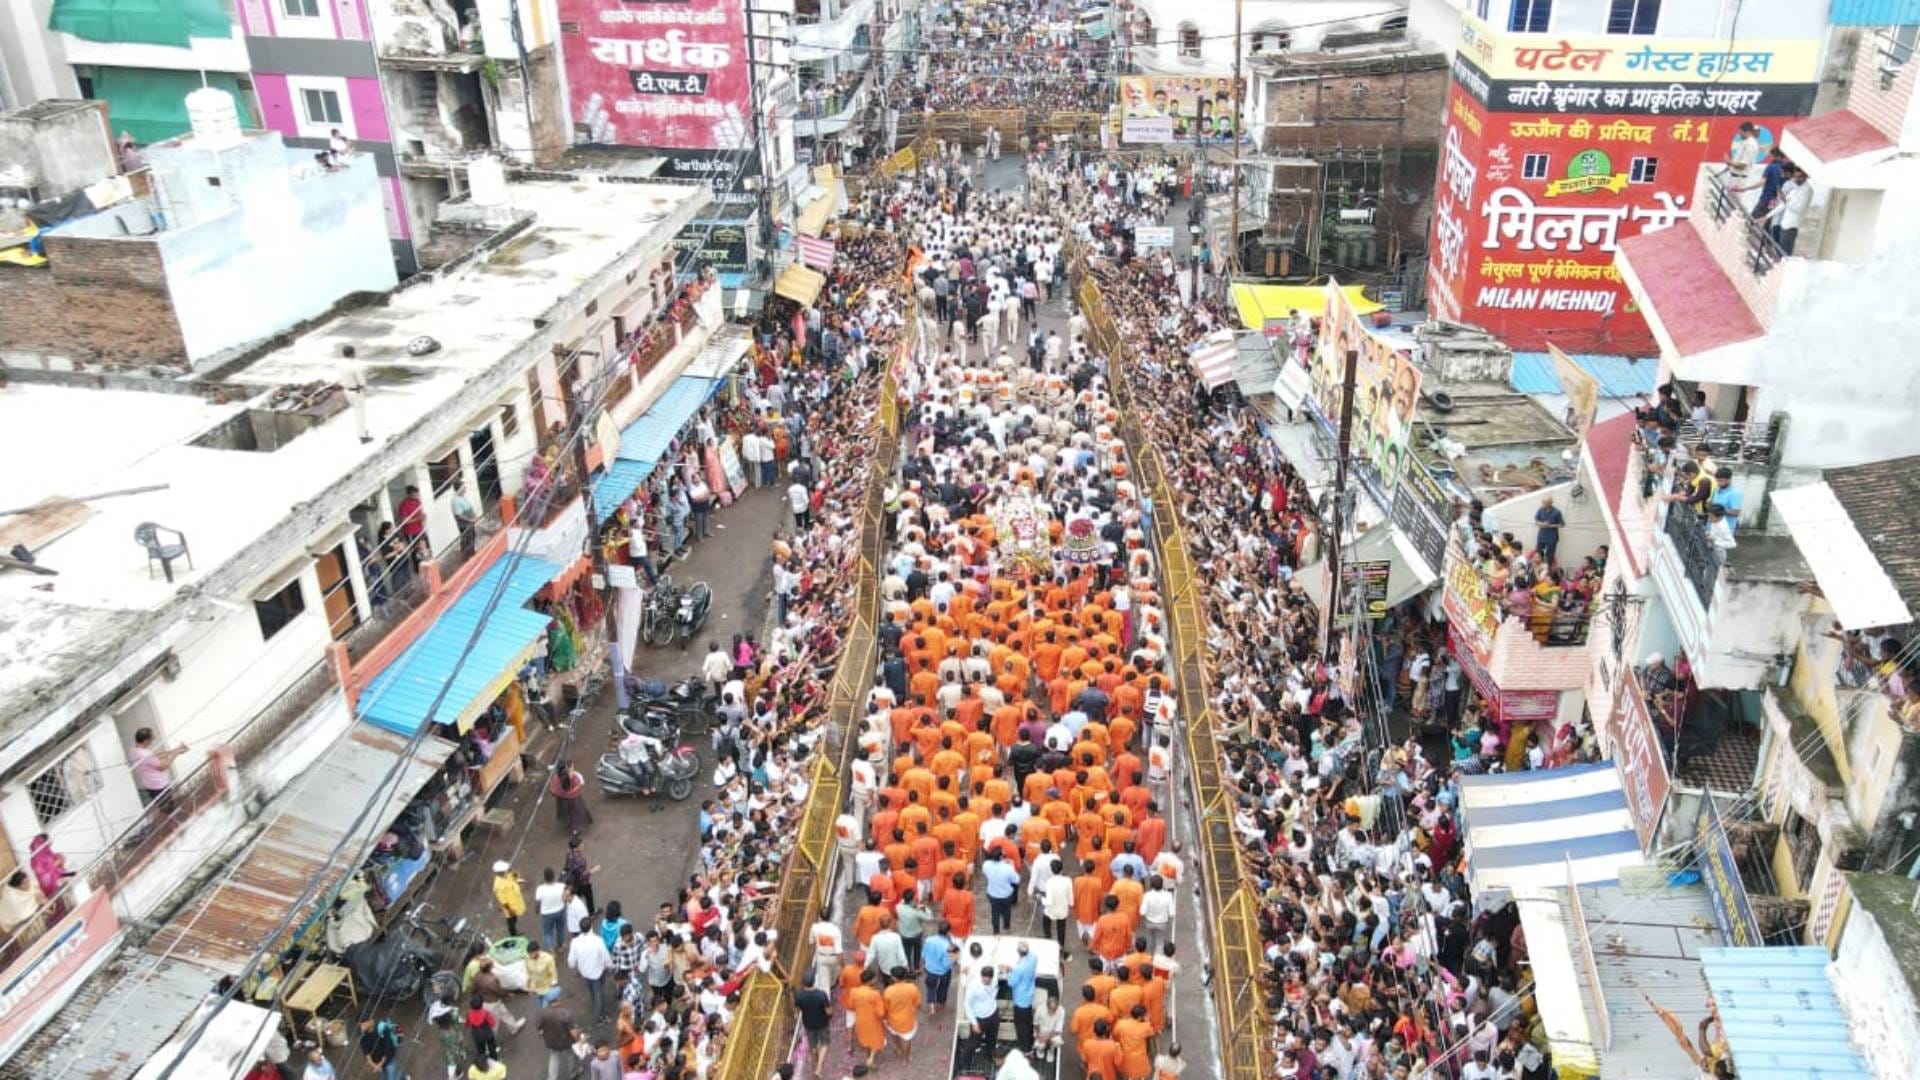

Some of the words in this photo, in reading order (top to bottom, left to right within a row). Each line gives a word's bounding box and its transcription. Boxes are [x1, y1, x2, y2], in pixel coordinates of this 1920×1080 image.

[588, 29, 730, 68] सार्थक
[1514, 40, 1613, 72] पटेल
[1626, 44, 1694, 71] गेस्ट
[1697, 51, 1773, 77] हाउस
[1508, 81, 1551, 107] नारी
[1604, 88, 1628, 108] का
[1630, 83, 1703, 114] प्राकृतिक
[1703, 86, 1762, 113] उपहार
[1510, 118, 1564, 138] उज्जैन
[1568, 118, 1593, 140] की
[1598, 119, 1656, 143] प्रसिद्ध
[674, 158, 714, 171] Sarthak
[1482, 186, 1629, 251] मिलन
[1528, 258, 1554, 283] पूर्ण
[1477, 287, 1538, 310] MILAN
[1539, 290, 1616, 313] MEHNDI
